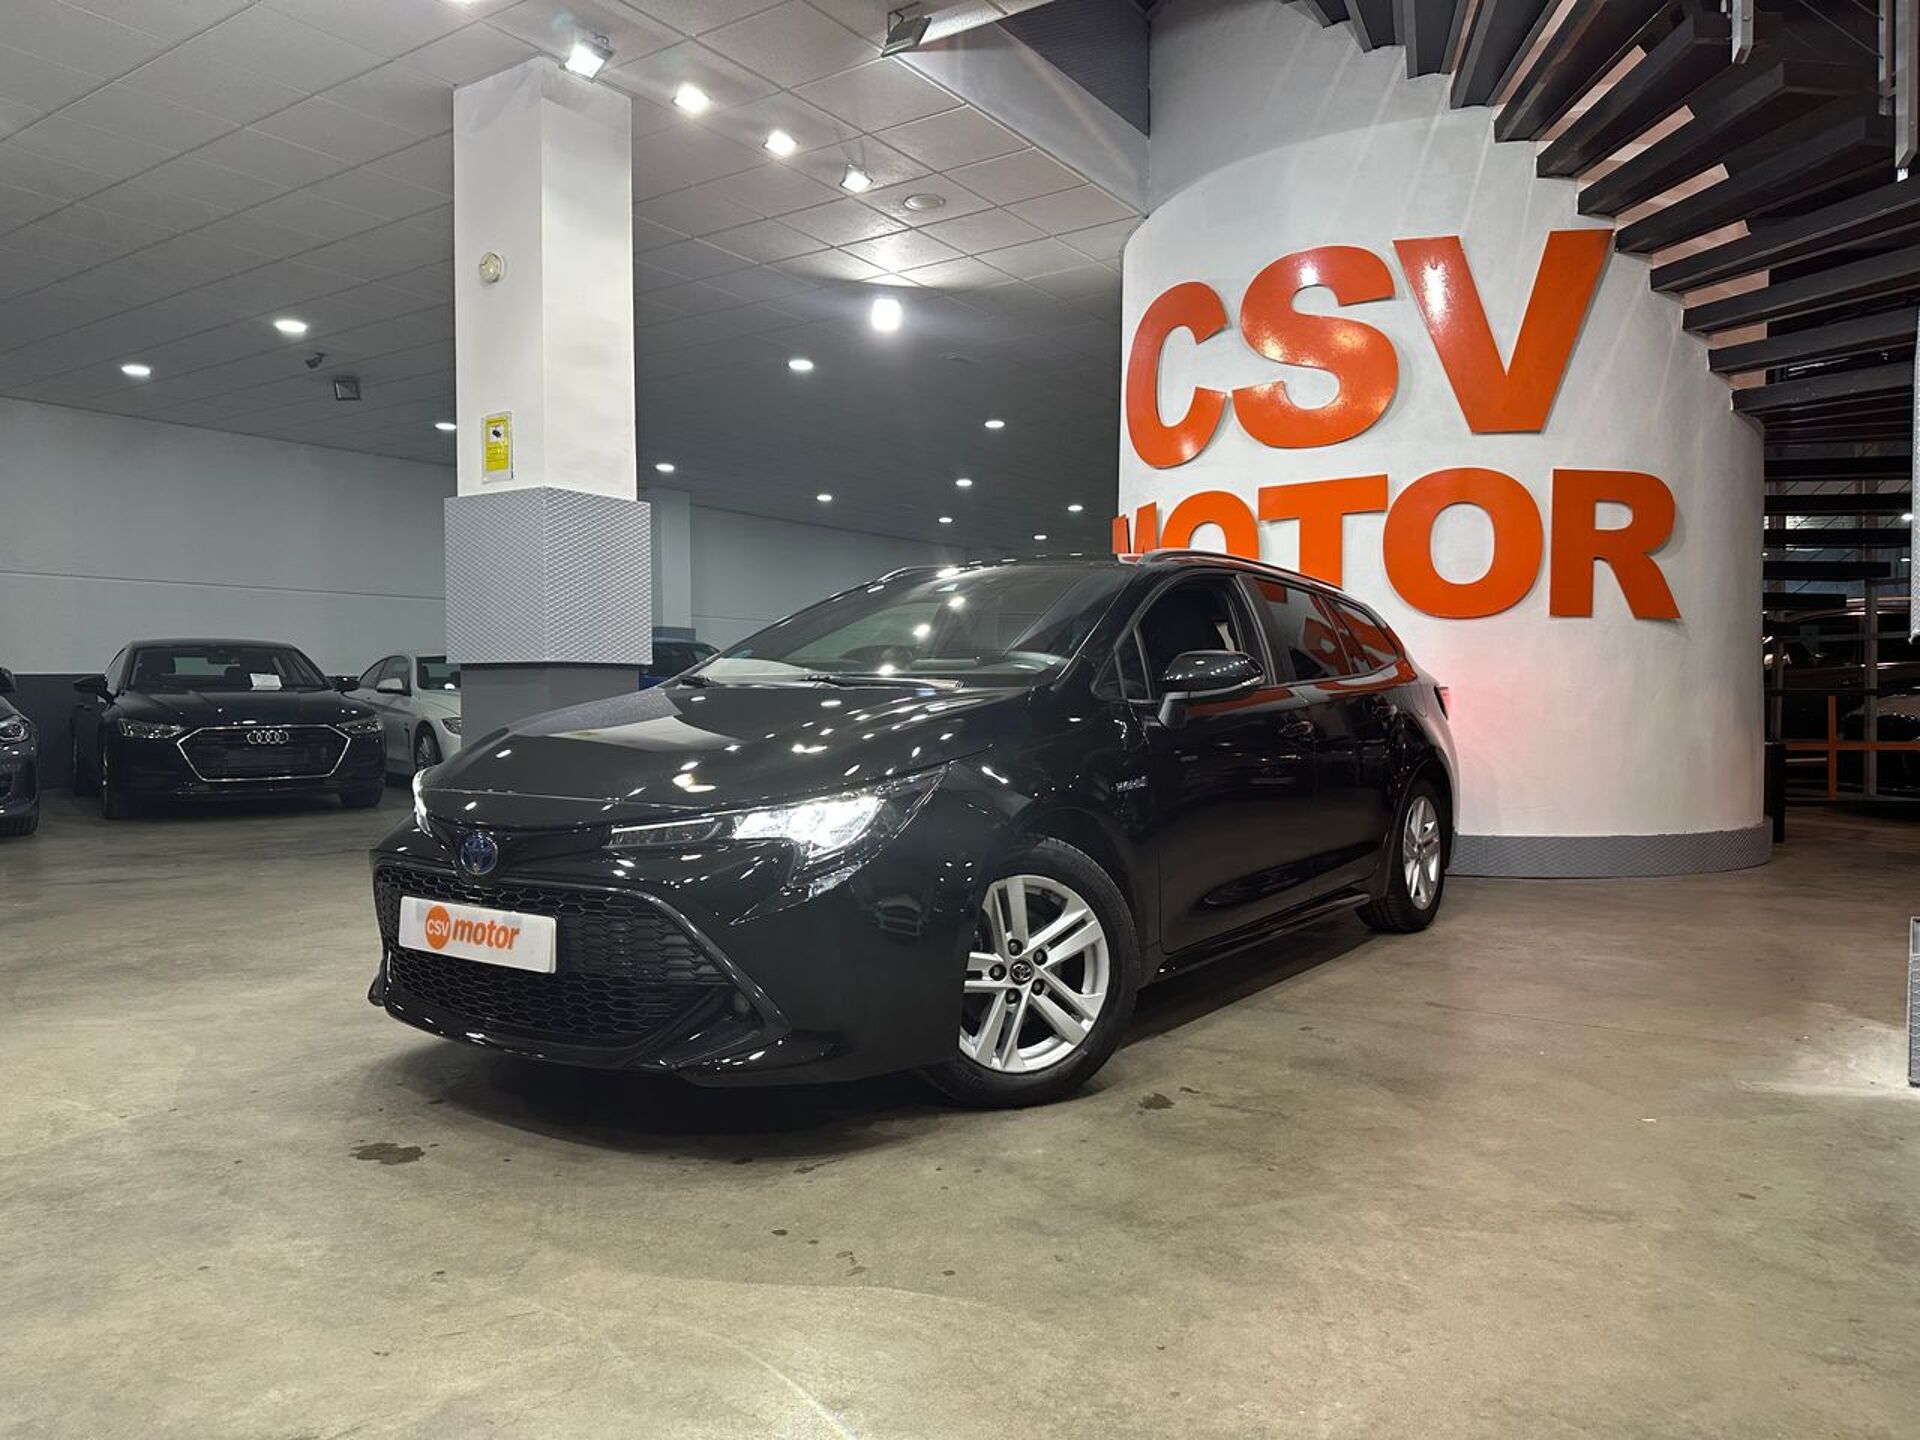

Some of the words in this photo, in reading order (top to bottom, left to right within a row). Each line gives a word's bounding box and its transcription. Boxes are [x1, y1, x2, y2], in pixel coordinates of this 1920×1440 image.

[1126, 229, 1613, 468] CSV
[426, 919, 450, 935] CSV
[453, 918, 520, 950] motor
